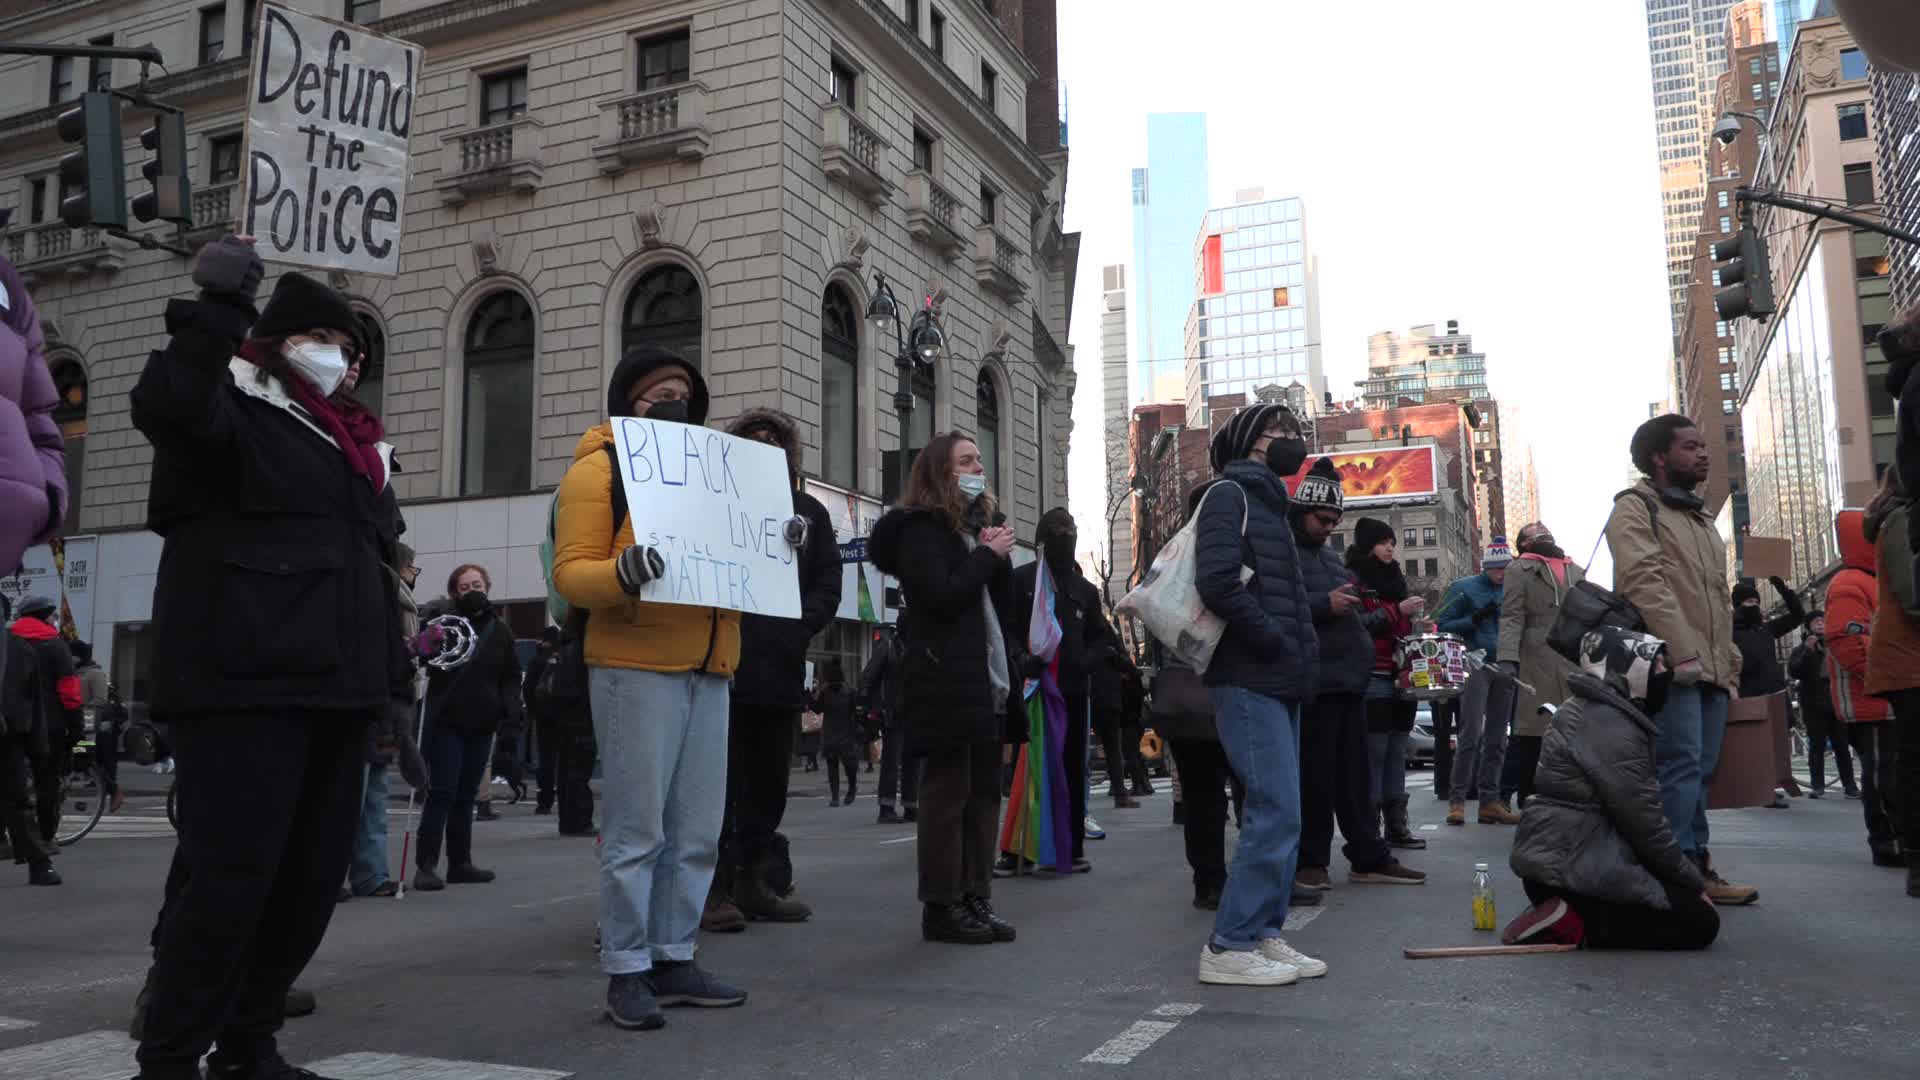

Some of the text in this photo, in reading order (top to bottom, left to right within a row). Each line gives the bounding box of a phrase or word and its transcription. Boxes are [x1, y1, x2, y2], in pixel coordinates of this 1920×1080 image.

[258, 8, 413, 139] Defund
[246, 151, 398, 259] Police
[621, 418, 740, 499] BLACK
[649, 532, 713, 556] STILL
[652, 552, 759, 611] MATTER
